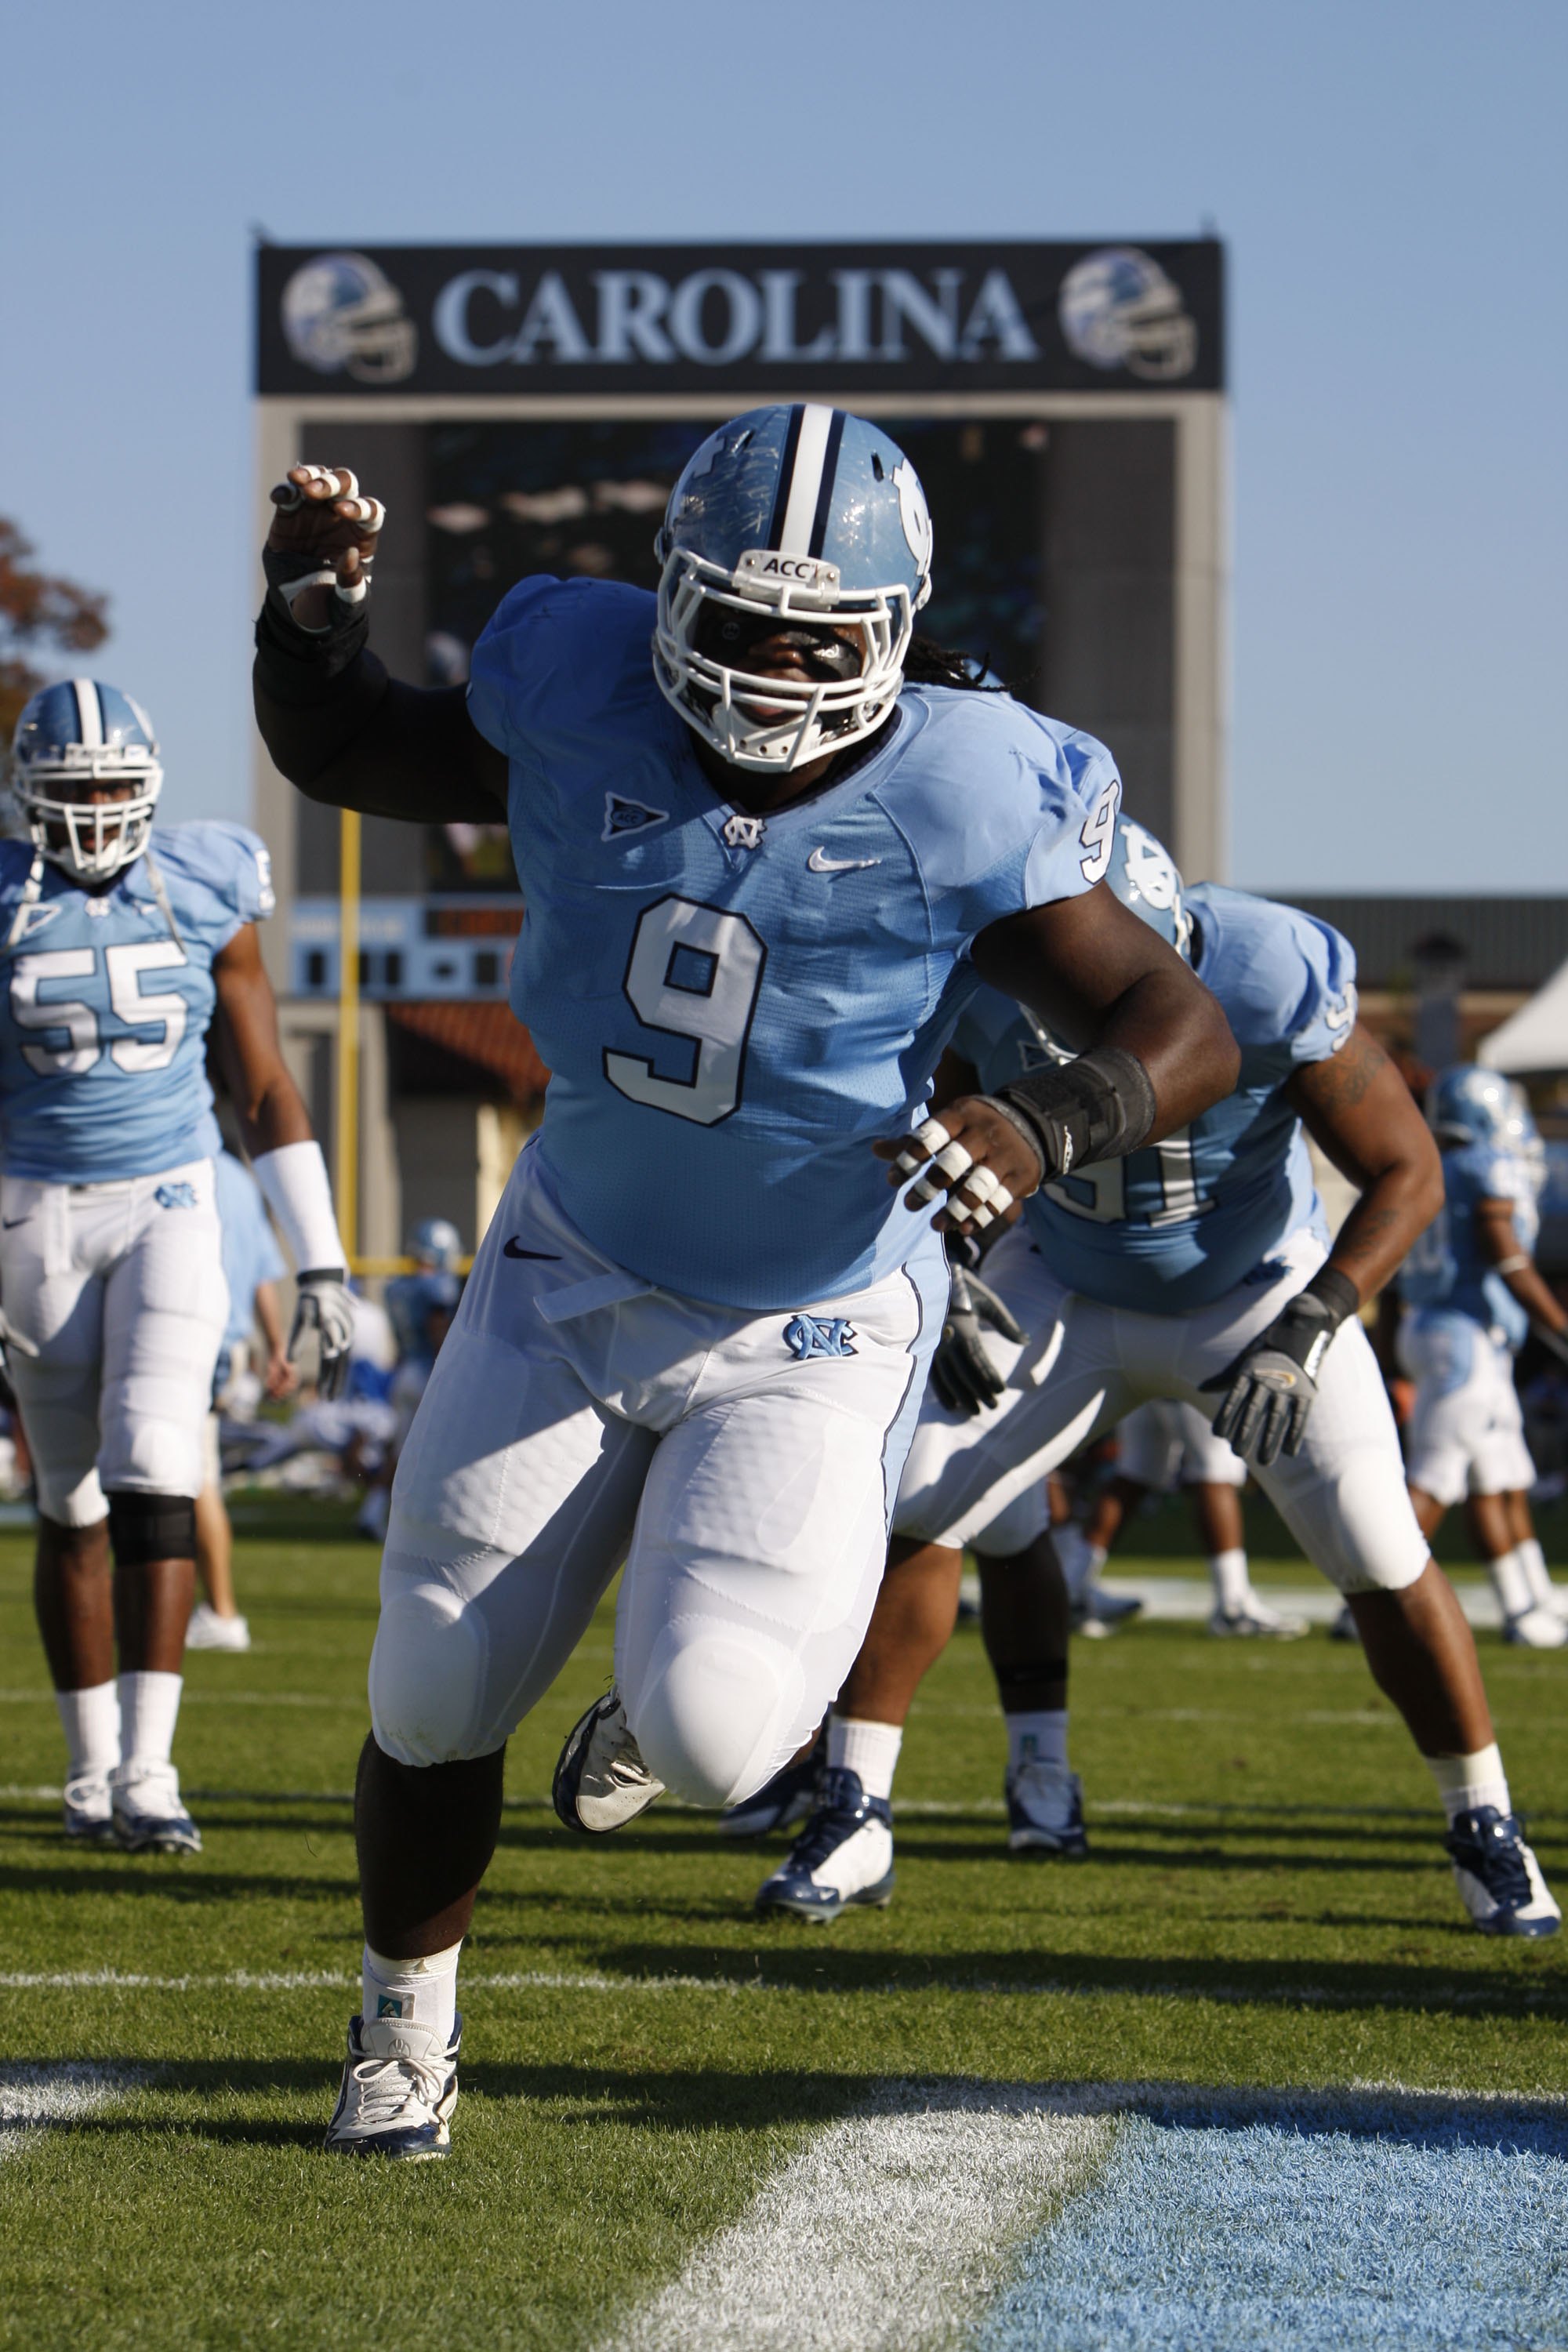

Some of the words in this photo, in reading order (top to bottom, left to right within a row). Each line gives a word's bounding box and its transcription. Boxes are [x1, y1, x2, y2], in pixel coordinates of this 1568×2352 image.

[432, 267, 1040, 365] CAROLINA
[763, 558, 811, 579] ACC
[1079, 779, 1120, 885] 9
[9, 941, 188, 1076] 55
[601, 892, 768, 1129] 9
